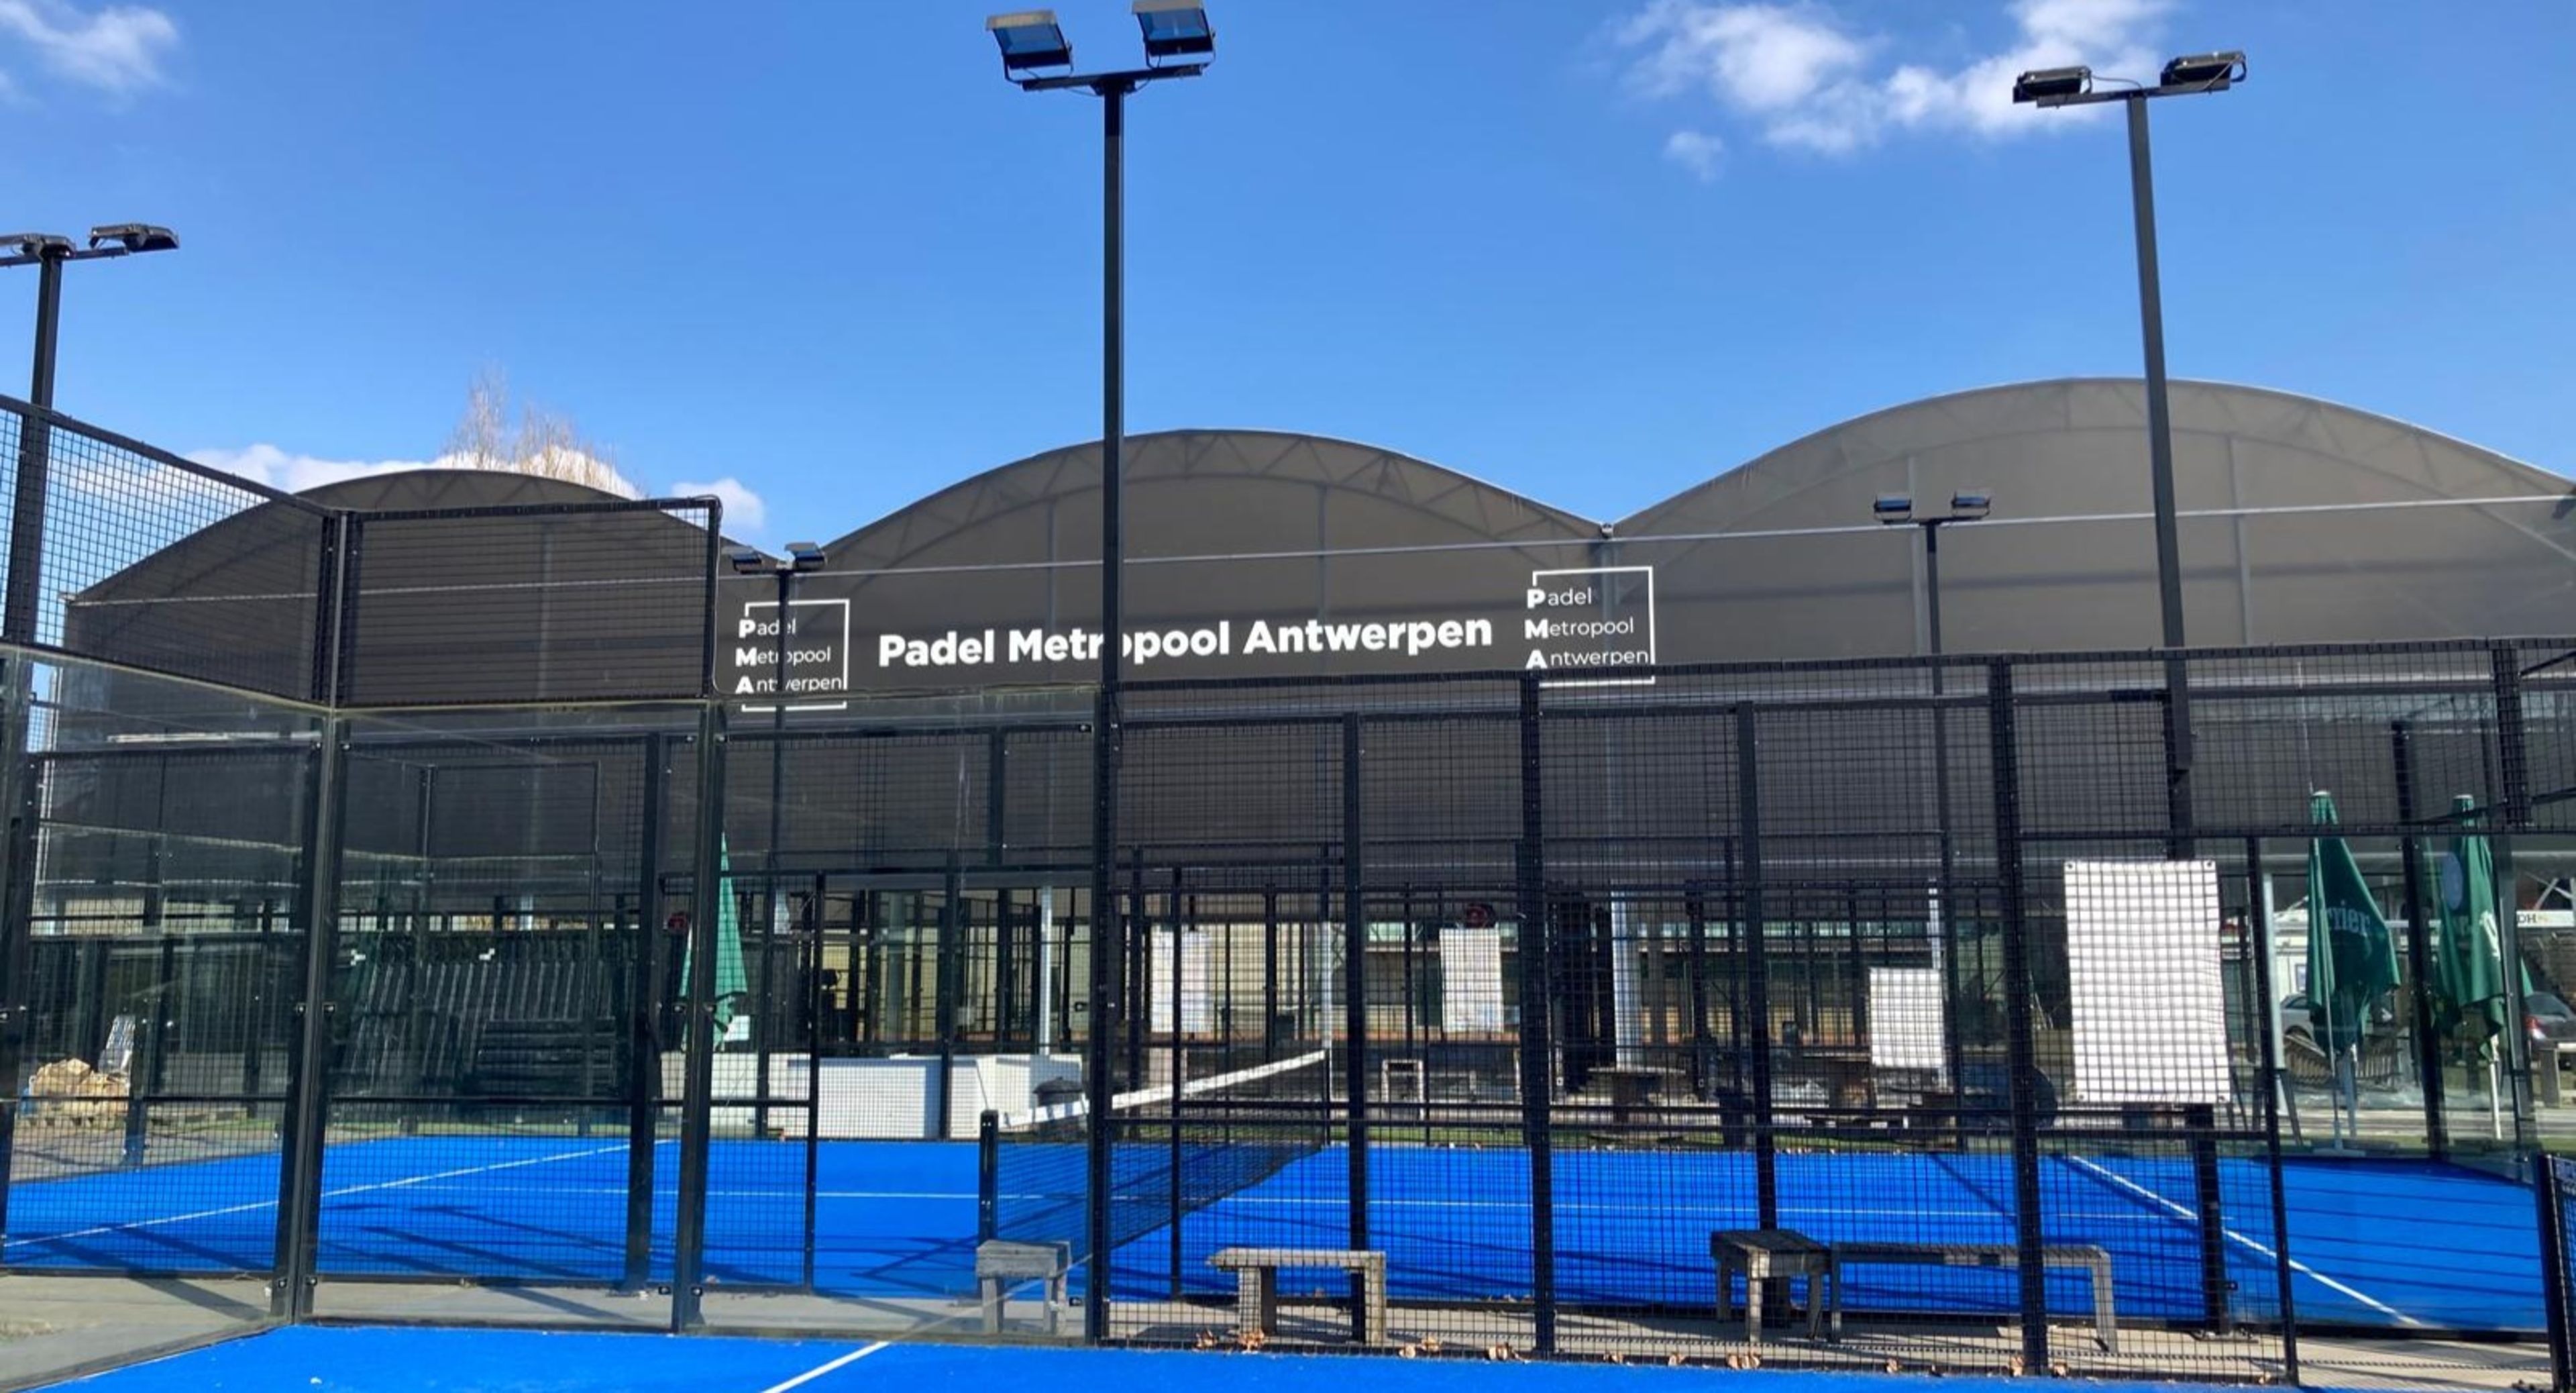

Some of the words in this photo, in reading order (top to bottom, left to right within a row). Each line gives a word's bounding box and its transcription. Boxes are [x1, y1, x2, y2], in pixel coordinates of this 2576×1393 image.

[1526, 586, 1592, 609] Padel
[1524, 616, 1634, 639] Metropool
[879, 629, 995, 667] Padel
[1242, 618, 1493, 656] Antwerpen
[1525, 648, 1650, 670] Antwerpen
